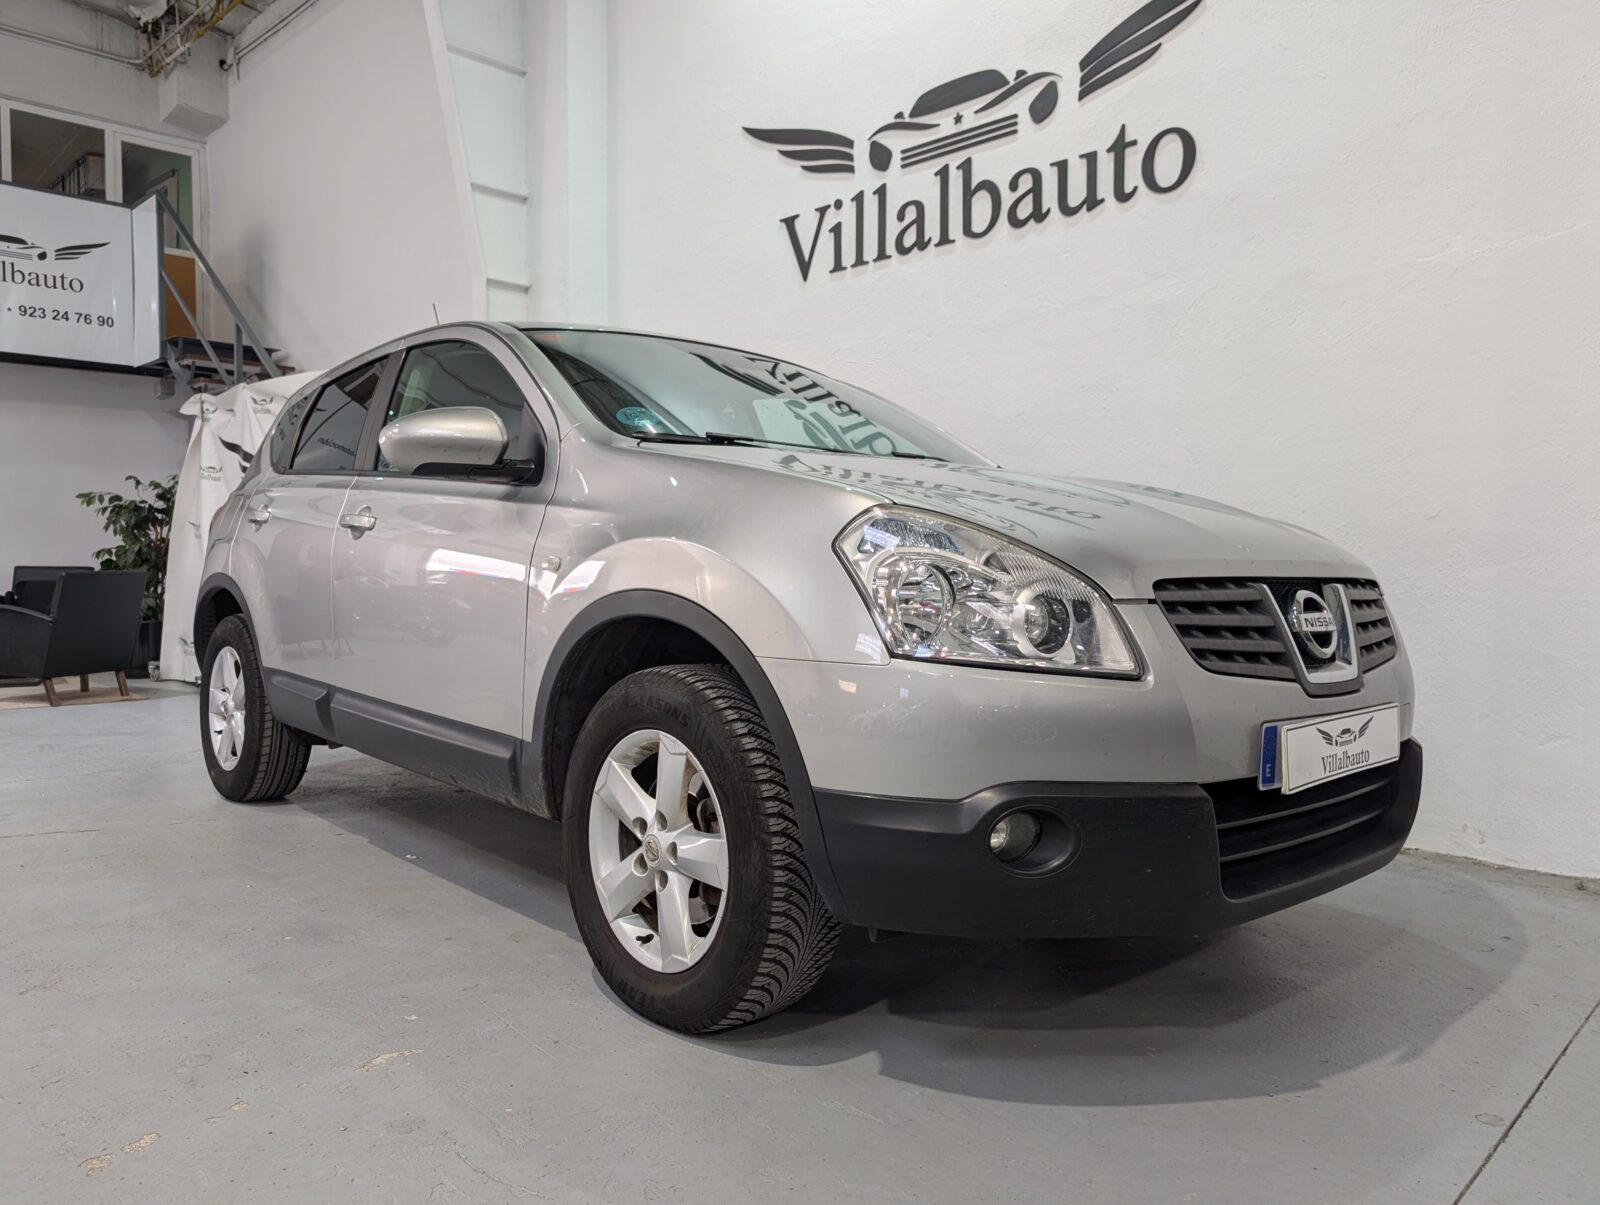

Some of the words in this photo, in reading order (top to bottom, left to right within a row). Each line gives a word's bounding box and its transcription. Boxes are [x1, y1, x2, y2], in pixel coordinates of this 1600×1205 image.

[780, 124, 1196, 282] Villalbauto
[18, 305, 47, 319] 923
[51, 309, 70, 322] 24
[74, 312, 93, 325] 76
[96, 315, 114, 328] 90
[1265, 763, 1272, 777] E
[1321, 749, 1370, 774] Villalbauto
